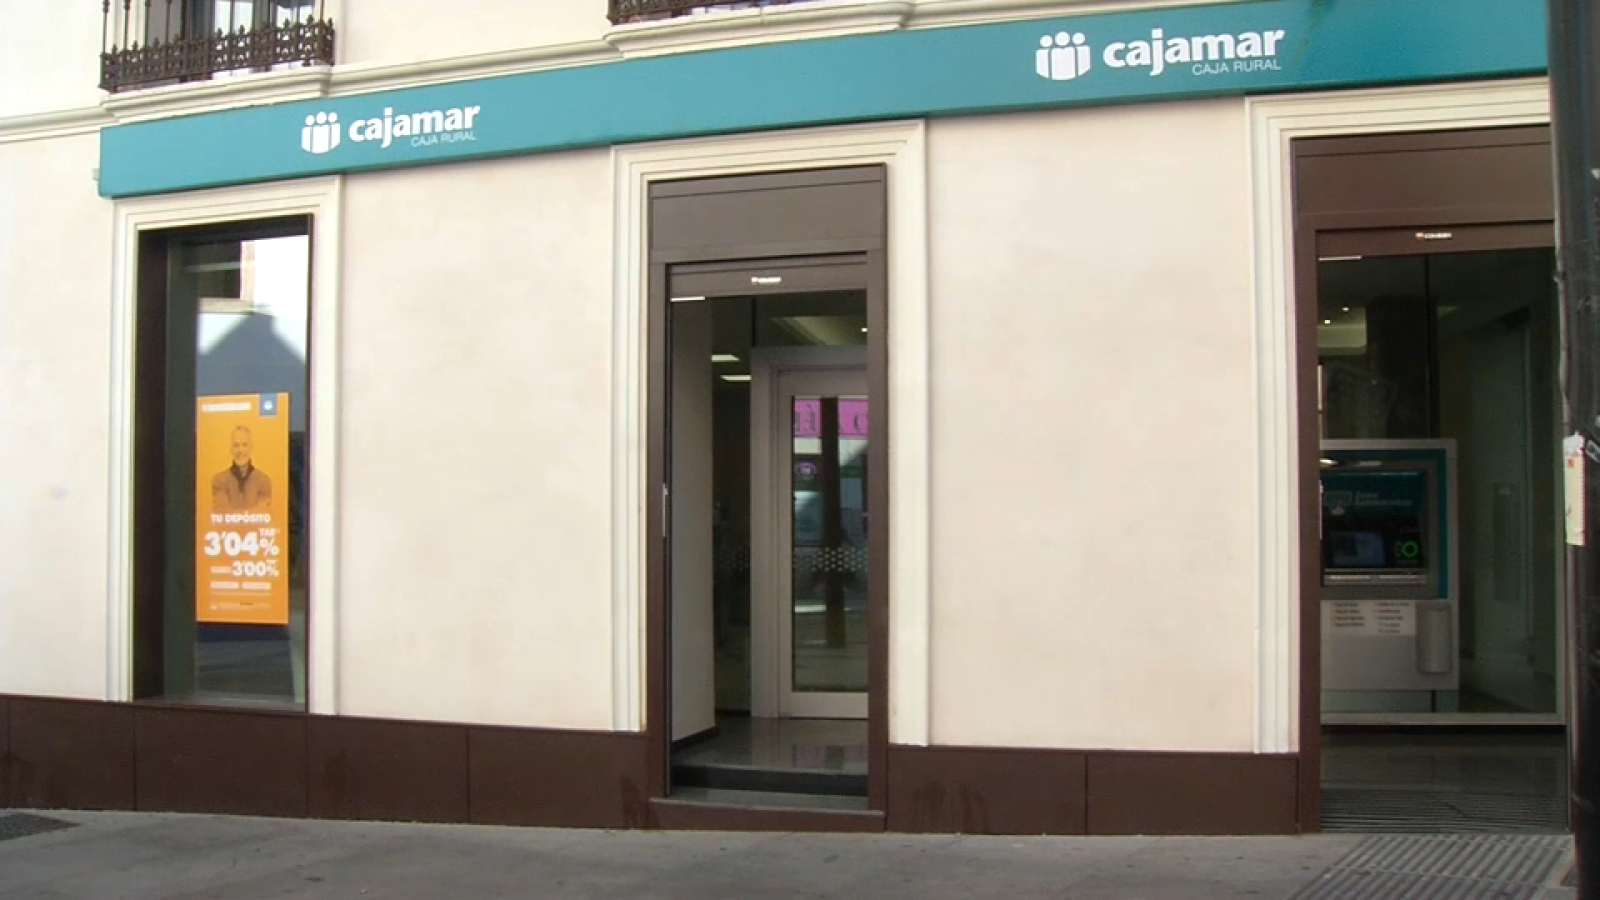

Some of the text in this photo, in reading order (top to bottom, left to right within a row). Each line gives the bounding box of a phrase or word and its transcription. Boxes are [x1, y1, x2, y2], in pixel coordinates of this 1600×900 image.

[1103, 28, 1285, 76] cajamar
[1192, 59, 1282, 76] CAJA RURAL
[348, 105, 480, 149] cajamar
[411, 131, 477, 148] CAJA RURAL
[210, 510, 271, 524] TU DEPÓSITO
